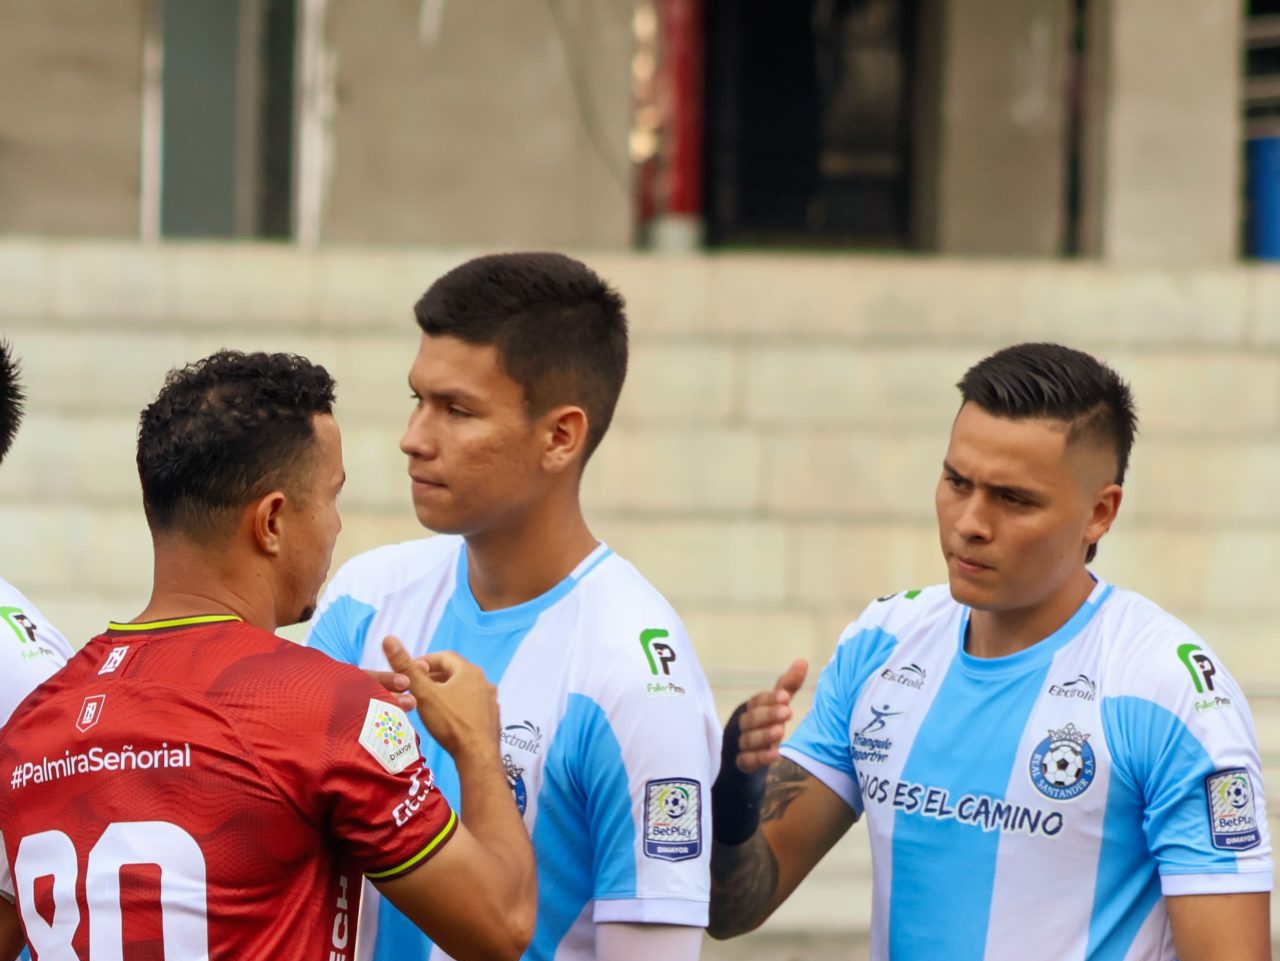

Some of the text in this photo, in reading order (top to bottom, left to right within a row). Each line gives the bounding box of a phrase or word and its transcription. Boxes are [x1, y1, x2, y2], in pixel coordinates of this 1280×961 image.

[499, 729, 542, 756] ectrolit
[10, 742, 191, 790] #PalmiraSeñorial
[892, 782, 923, 812] ES
[923, 790, 954, 817] EL
[957, 797, 1065, 837] CAMINO
[653, 824, 692, 837] BetPlay
